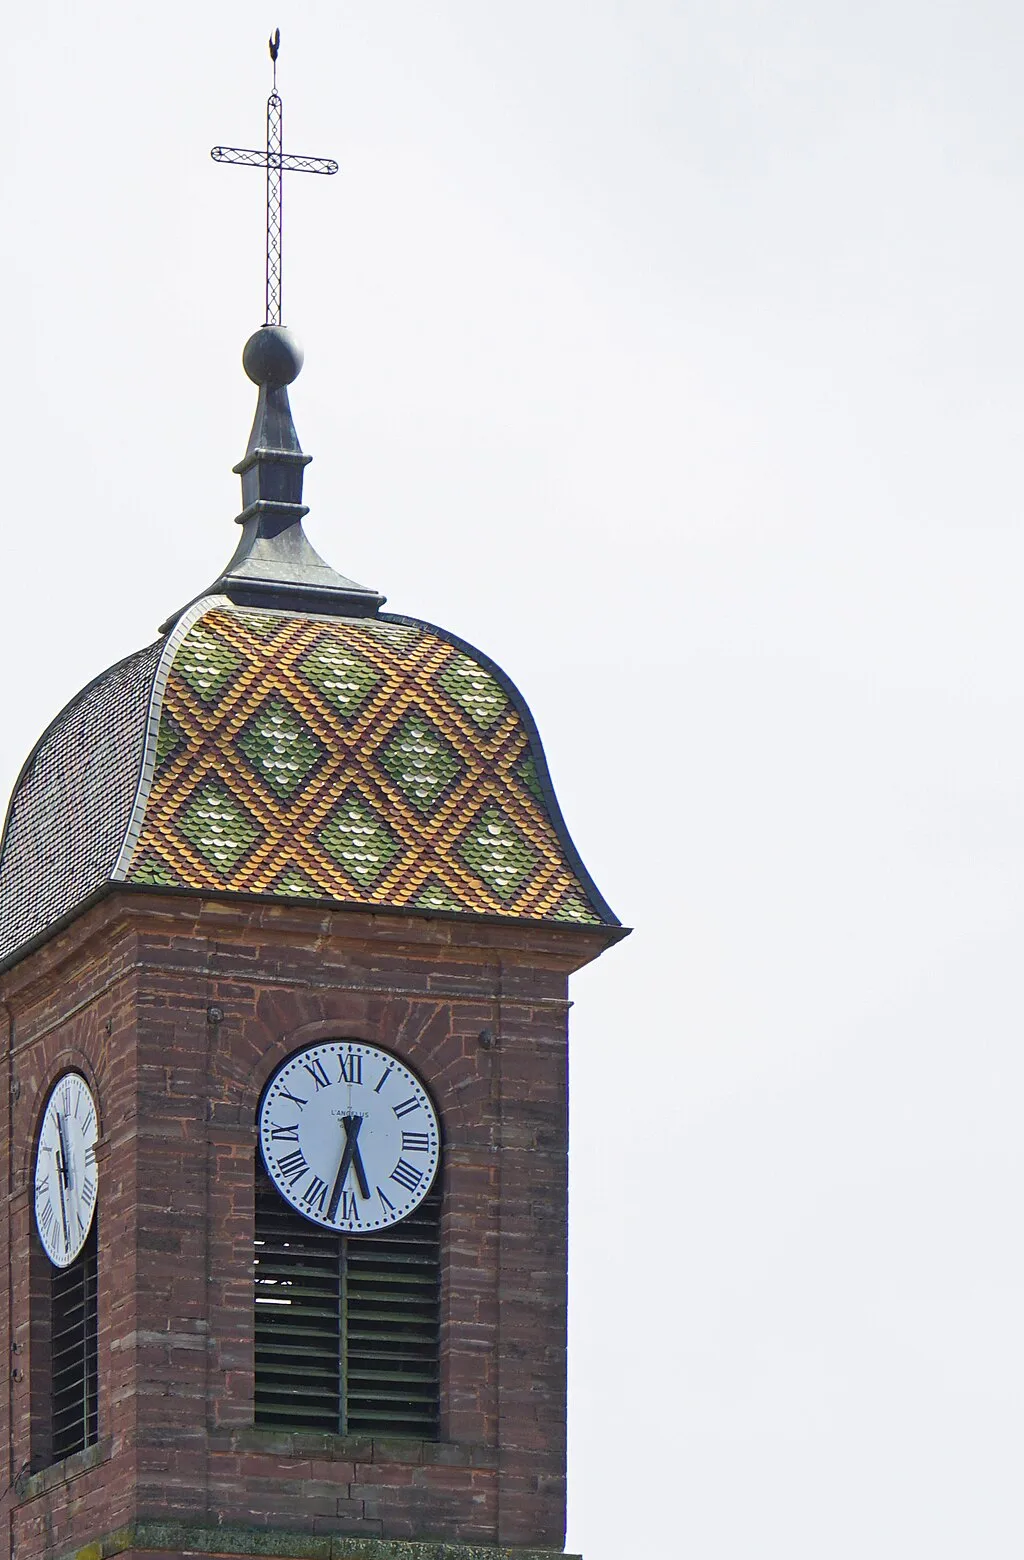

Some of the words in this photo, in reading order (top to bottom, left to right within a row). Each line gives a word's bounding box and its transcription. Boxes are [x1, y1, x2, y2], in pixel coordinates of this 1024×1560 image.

[303, 1058, 332, 1092] XI
[337, 1054, 363, 1085] XII
[373, 1067, 392, 1094] I
[278, 1085, 308, 1112] X
[392, 1095, 421, 1119] II
[271, 1122, 299, 1142] IX
[401, 1131, 429, 1152] III
[276, 1148, 310, 1187] VIII
[301, 1175, 329, 1212] VII
[376, 1186, 396, 1214] V
